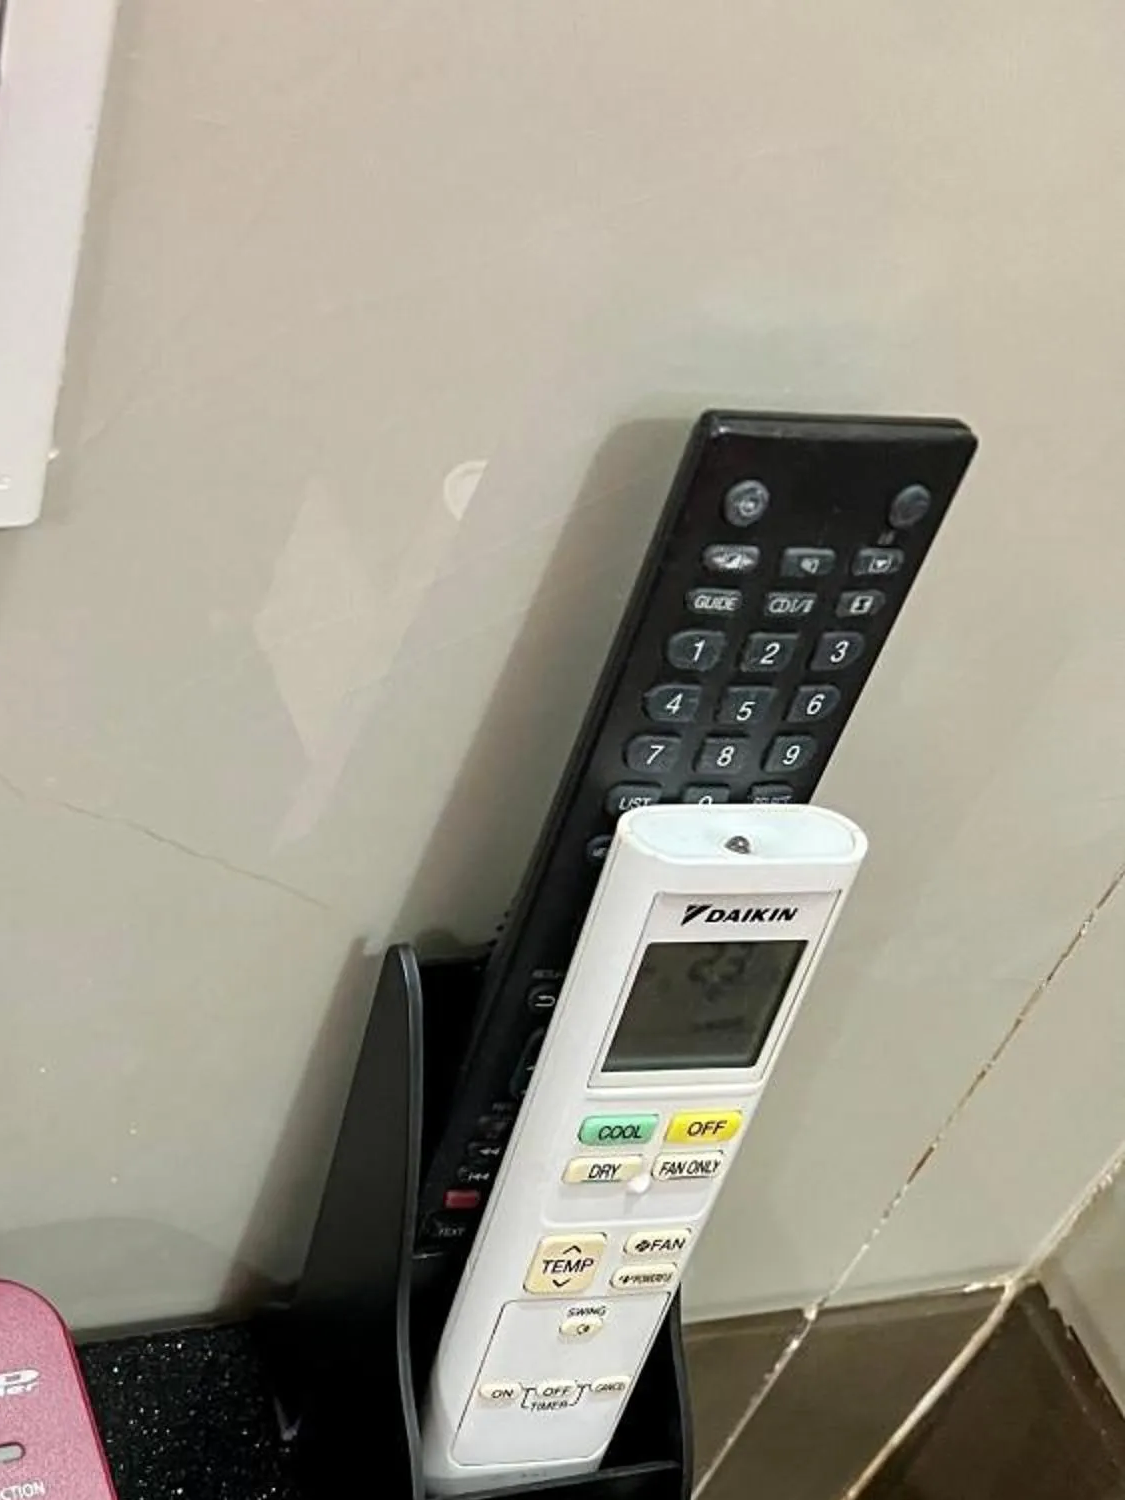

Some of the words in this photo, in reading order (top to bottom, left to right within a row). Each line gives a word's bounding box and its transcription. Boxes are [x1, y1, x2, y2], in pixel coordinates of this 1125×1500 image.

[694, 595, 737, 611] GUIDE
[694, 639, 706, 661] 1
[759, 641, 780, 664] 2
[830, 641, 849, 662] 3
[666, 694, 682, 713] 4
[736, 701, 754, 721] 5
[806, 694, 823, 715] 6
[646, 745, 664, 764] 7
[717, 746, 734, 766] 8
[784, 745, 801, 765] 9
[705, 906, 798, 924] DAIKIN
[598, 1124, 644, 1141] COOL
[687, 1120, 728, 1136] OFF
[588, 1163, 621, 1179] DRY
[659, 1161, 687, 1176] FAN
[687, 1159, 721, 1174] ONLY
[650, 1238, 686, 1252] FAN
[542, 1257, 594, 1275] TEMP
[567, 1305, 606, 1317] SWING
[491, 1389, 514, 1399] ON
[542, 1386, 575, 1397] OFF
